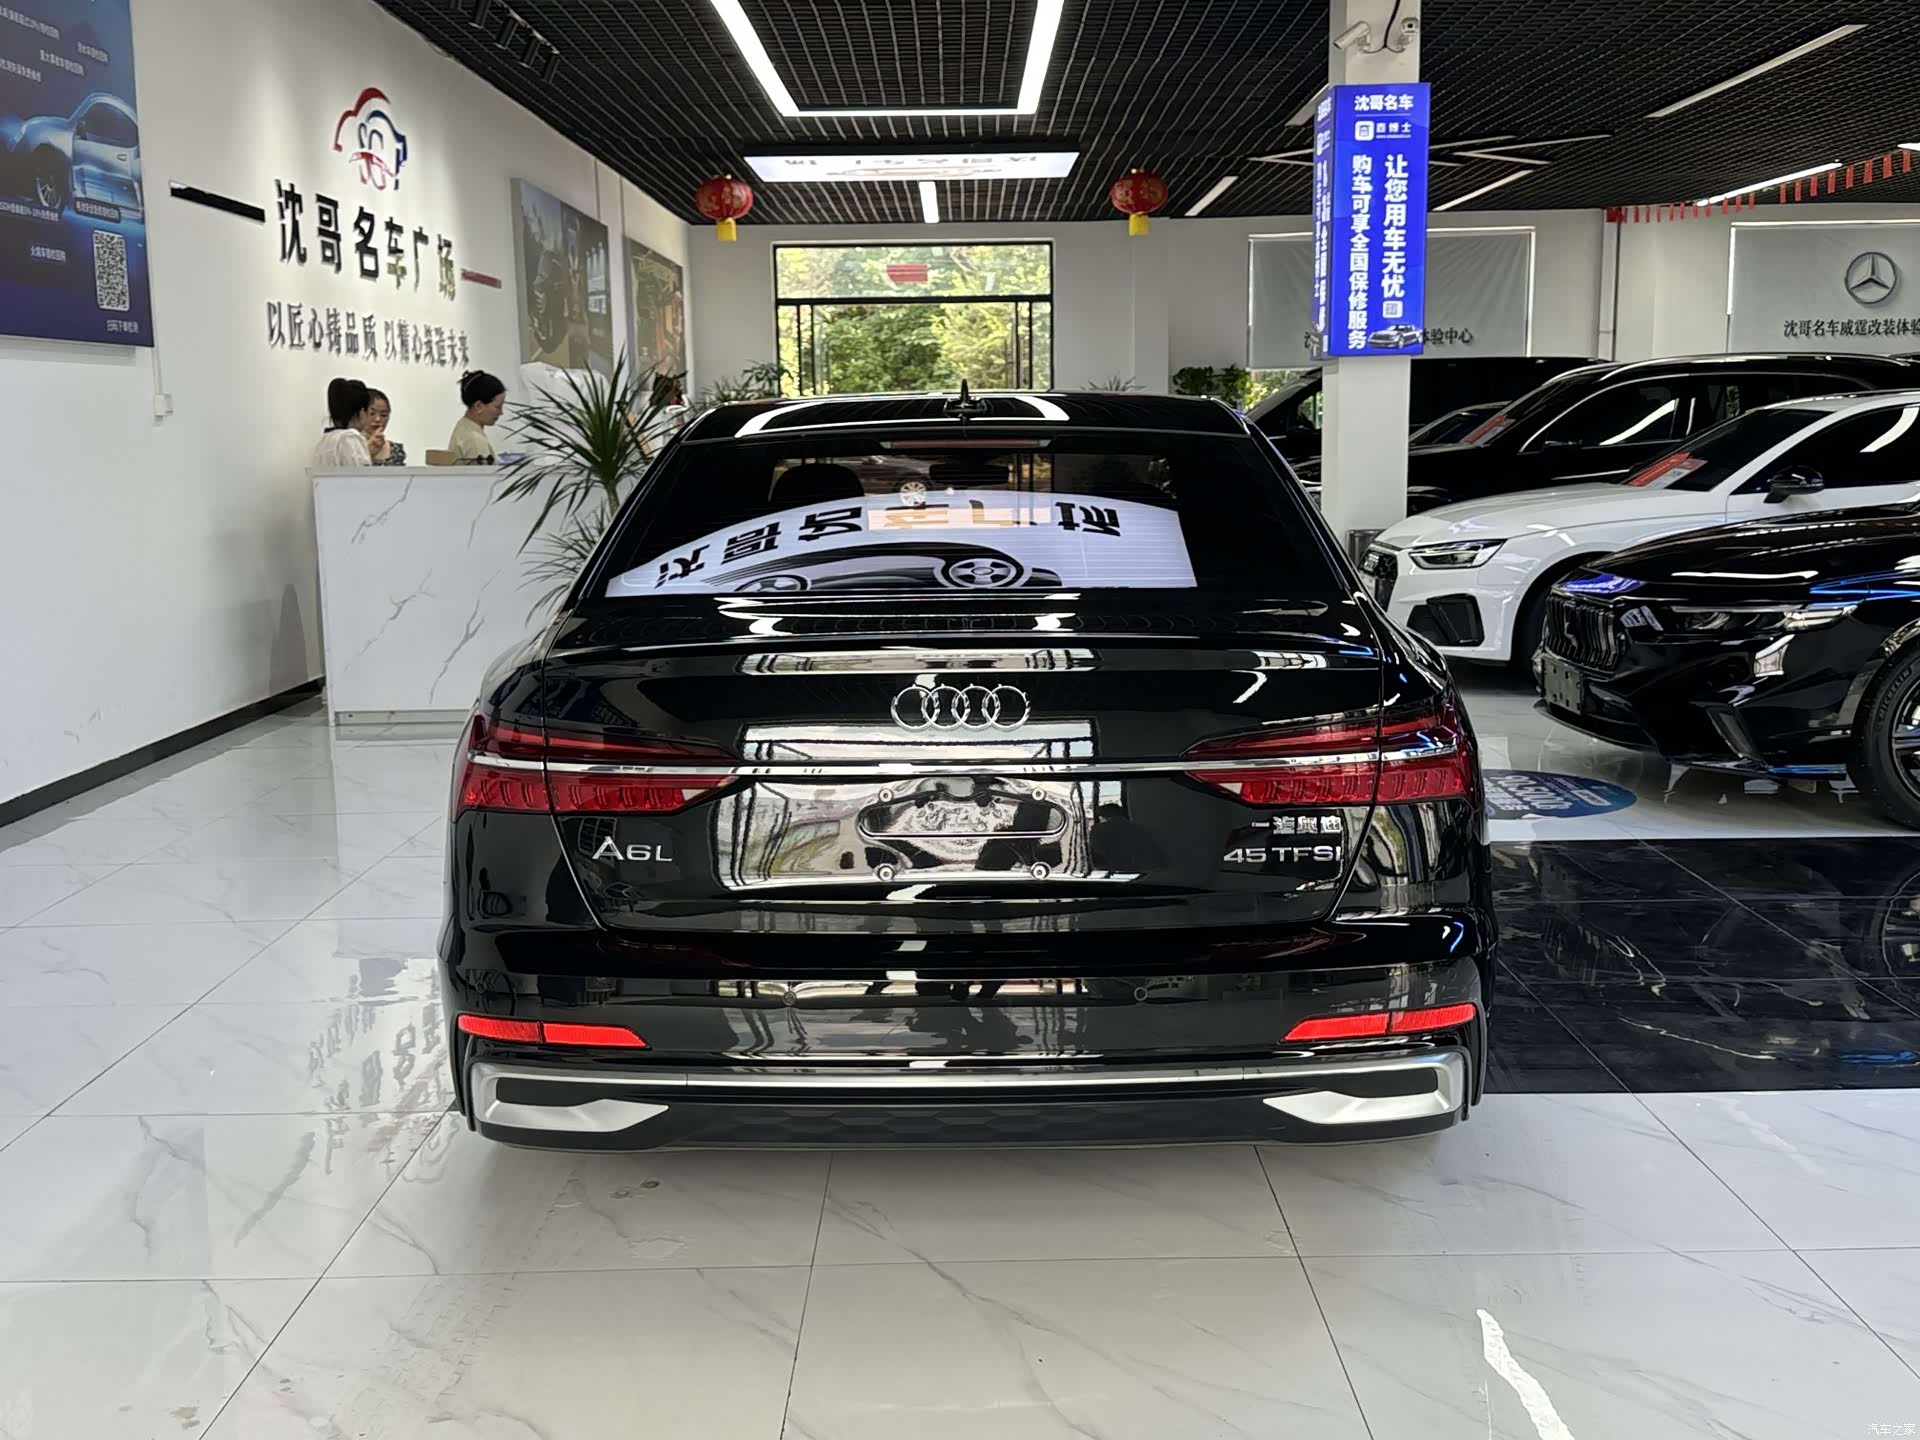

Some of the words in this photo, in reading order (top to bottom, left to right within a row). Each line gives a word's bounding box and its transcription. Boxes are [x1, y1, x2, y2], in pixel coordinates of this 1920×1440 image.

[1354, 94, 1415, 111] 沈哥名车
[273, 178, 457, 300] 沈哥名车广场
[1347, 154, 1373, 350] 购车可享全国保修服务
[1381, 153, 1409, 298] 让您用车无忧
[592, 836, 672, 861] A6L
[1223, 847, 1267, 863] 45
[1272, 845, 1342, 863] TFSI
